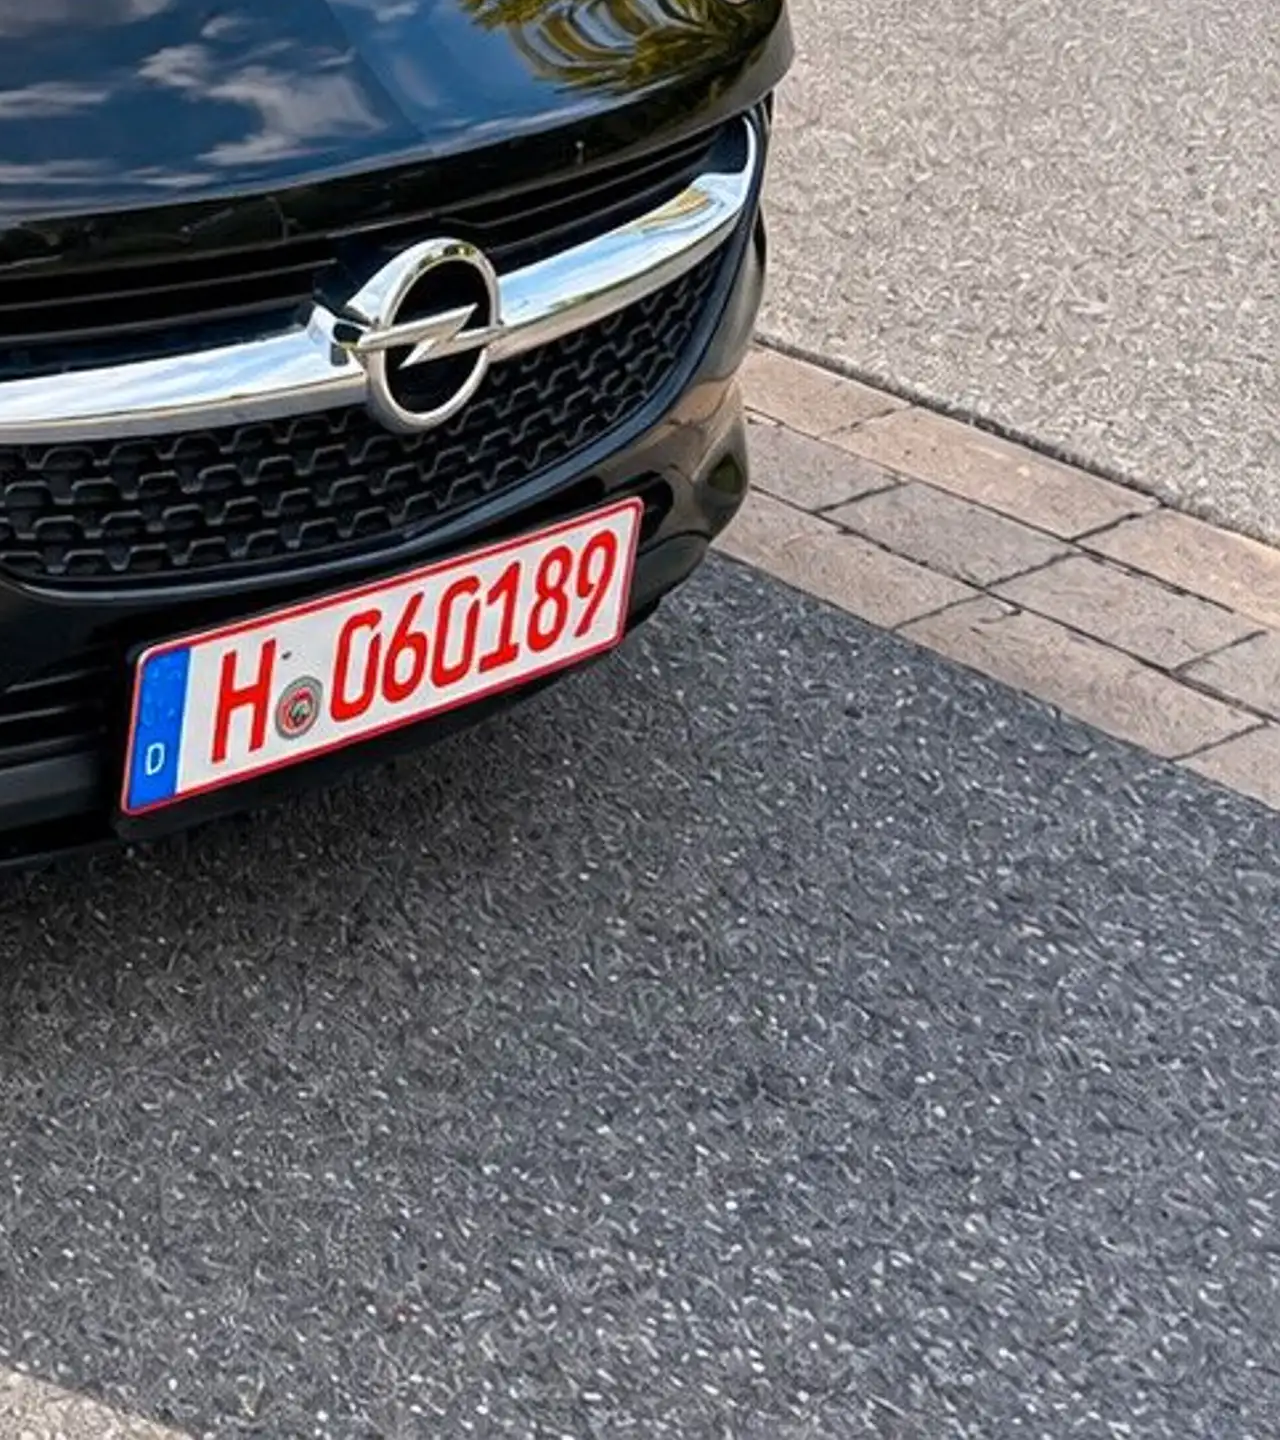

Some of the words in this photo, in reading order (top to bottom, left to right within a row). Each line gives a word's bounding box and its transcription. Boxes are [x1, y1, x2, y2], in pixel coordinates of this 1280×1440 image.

[211, 638, 276, 764] H
[330, 530, 617, 722] 060189
[146, 742, 165, 775] D
